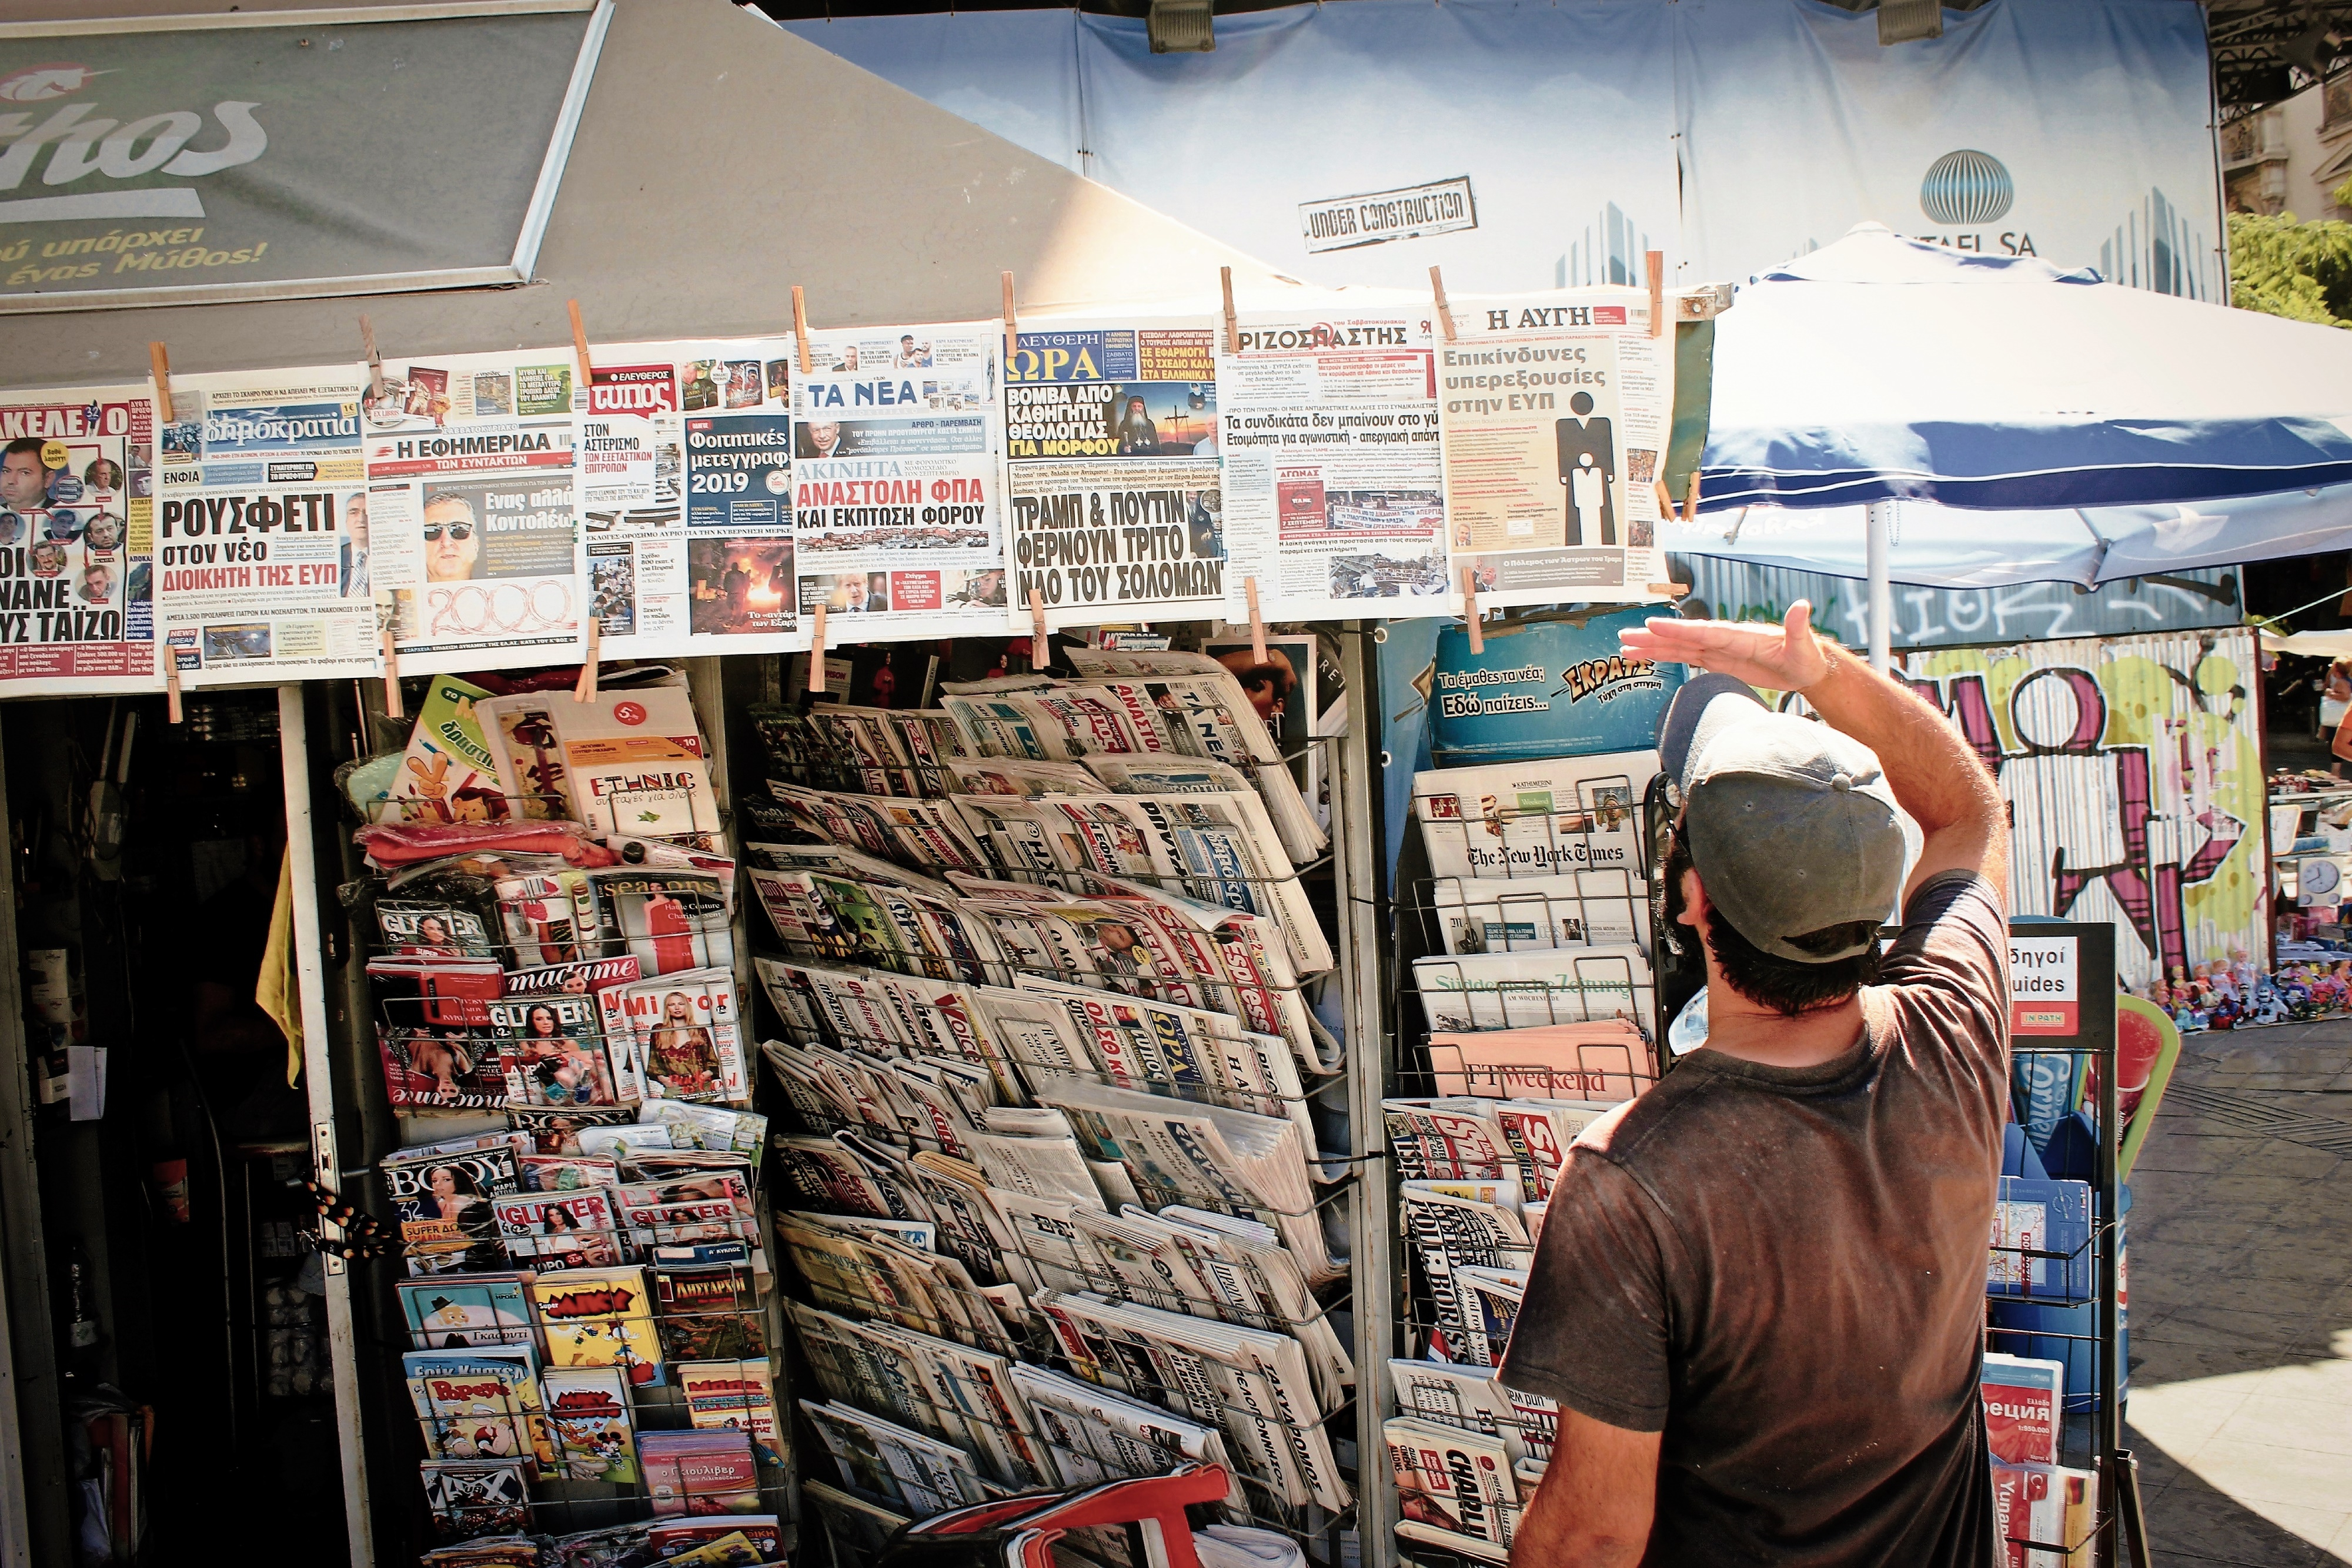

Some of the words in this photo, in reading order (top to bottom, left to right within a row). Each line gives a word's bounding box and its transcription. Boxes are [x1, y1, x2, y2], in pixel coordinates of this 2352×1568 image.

[1309, 206, 1357, 239] UNDER
[1359, 192, 1464, 232] CONSTRUCTION
[42, 228, 204, 258] υπάρχει
[2000, 232, 2037, 257] SA
[6, 262, 101, 285] ένας
[114, 243, 268, 273] Μύθος!
[1487, 310, 1509, 330] Η
[1518, 306, 1591, 328] ΑΥΓΗ
[1239, 327, 1407, 350] ΡΙΖΟΣΠΑΣΤΗΣ
[1141, 348, 1152, 357] ΣΕ
[1155, 347, 1205, 357] ΕΦΑΡΜΟΓΗ
[1444, 346, 1586, 367] Επικίνδυνες
[1006, 347, 1102, 382] ΩΡΑ
[1141, 359, 1153, 369] ΤΟ
[1156, 359, 1188, 369] ΣΧΕΔΙΟ
[619, 371, 669, 382] ΕΛΕΥΘΕΡΟΣ
[1142, 370, 1159, 380] ΣΤΑ
[1161, 370, 1208, 380] ΕΛΛΗΝΙΚΑ
[1445, 367, 1606, 392] υπερεξουσίες
[808, 384, 845, 408] ΤΑ
[855, 380, 917, 406] ΝΕΑ
[1007, 387, 1071, 406] ΒΟΜΒΑ
[1075, 385, 1114, 403] ΑΠΟ
[1447, 396, 1503, 415] στην
[1508, 392, 1555, 411] ΕΥΠ
[1008, 403, 1103, 424] ΚΑΘΗΓΗΤΗ
[1225, 415, 1241, 429] Τα
[1244, 413, 1309, 429] συνδικάτα
[1312, 413, 1334, 426] δεν
[1338, 413, 1394, 430] μπαίνουν
[1398, 413, 1420, 426] στο
[207, 412, 358, 447] δημοκρατία
[584, 423, 609, 437] ΣΤΟΝ
[911, 420, 934, 429] ΑΡΘΡΟ
[1008, 421, 1108, 440] ΘΕΟΛΟΓΙΑΣ
[398, 442, 413, 458] Η
[419, 433, 552, 457] ΕΦΗΜΕΡΙΔΑ
[584, 437, 639, 451] ΑΣΤΕΡΙΣΜΟ
[689, 429, 786, 448] Φοιτητικές
[1009, 440, 1038, 456] ΓΙΑ
[1043, 439, 1120, 456] ΜΟΡΦΟΥ
[1227, 432, 1279, 447] Ετοιμότητα
[1282, 433, 1296, 446] για
[1299, 430, 1350, 446] αγωνιστική
[1359, 429, 1408, 446] απεργιακή
[435, 460, 459, 470] ΤΩΝ
[462, 456, 527, 468] ΣΥΝΤΑΚΤΩΝ
[584, 453, 599, 462] ΤΩΝ
[601, 452, 652, 462] ΕΞΕΤΑΣΤΙΚΩΝ
[164, 471, 200, 484] ΕΝΦΙΑ
[585, 463, 627, 473] ΕΠΙΤΡΟΠΩΝ
[796, 460, 903, 481] ΑΚΙΝΗΤΑ
[1280, 469, 1319, 478] ΑΓΩΝΑΣ
[691, 472, 750, 494] 2019
[797, 480, 921, 507] ΑΝΑΣΤΟΛΗ
[931, 479, 984, 503] ΦΠΑ
[485, 492, 526, 511] Ενας
[1013, 494, 1084, 531] ΤΡΑΜΠ
[1090, 492, 1106, 527] &
[1110, 490, 1185, 525] ΠΟΥΤΙΝ
[162, 493, 335, 538] ΡΟΥΣΦΕΤΙ
[797, 509, 826, 529] ΚΑΙ
[833, 507, 914, 526] ΕΚΠΤΩΣΗ
[922, 506, 985, 525] ΦΟΡΟΥ
[587, 531, 658, 541] ΕΚΛΟΓΕΣ-ΟΡΟΣΗΜΟ
[1017, 529, 1117, 568] ΦΕΡΝΟΥΝ
[1123, 525, 1184, 561] ΤΡΙΤΟ
[163, 544, 217, 566] στον
[225, 537, 267, 563] νέο
[1511, 559, 1544, 568] Πόλεμος
[162, 566, 250, 591] ΔΙΟΙΚΗΤΗ
[256, 565, 293, 586] ΤΗΣ
[299, 564, 337, 584] ΕΥΠ
[1068, 566, 1110, 601] ΤΟΥ
[37, 606, 120, 641] ΤΑΪΖΩ
[169, 637, 195, 645] BREAK
[1439, 674, 1456, 688] Τα
[1458, 668, 1500, 688] έμαθες
[1502, 672, 1516, 683] τα
[1518, 665, 1545, 683] νέα;
[1597, 688, 1618, 704] Τύχη
[1618, 683, 1632, 695] στη
[1633, 679, 1662, 693] στιγμή
[1445, 694, 1481, 716] Εδώ
[1485, 696, 1548, 713] παίζεις...
[1182, 692, 1202, 716] ΤΑ
[1198, 723, 1230, 764] ΝΕΑ
[683, 738, 696, 747] 10
[590, 772, 696, 797] ETHNIC
[1516, 780, 1552, 789] KATHIMERINI
[647, 795, 666, 807] για
[1467, 847, 1495, 867] The
[1534, 844, 1573, 868] York
[604, 881, 716, 897] seaons
[382, 915, 480, 935] GLITER
[2010, 946, 2065, 967] δηγοί
[508, 960, 636, 991] madame
[2013, 975, 2064, 992] uides
[1435, 975, 1555, 994] Süddeutsche
[1555, 974, 1631, 999] Zeitung
[1151, 1010, 1190, 1075] ΩΡΑ
[1465, 1064, 1500, 1086] FT
[1502, 1065, 1606, 1093] Weekend
[398, 1201, 423, 1223] 32
[407, 1225, 440, 1235] SUPER
[676, 1278, 746, 1299] ΛΗΣΤΑΡΧΟΙ
[473, 1329, 528, 1340] Γκαουντί
[432, 1380, 511, 1401] Popeye
[1264, 1363, 1323, 1493] ΤΑΧΥΔΡΟΜΟΣ
[2018, 1425, 2050, 1433] 1:950.000
